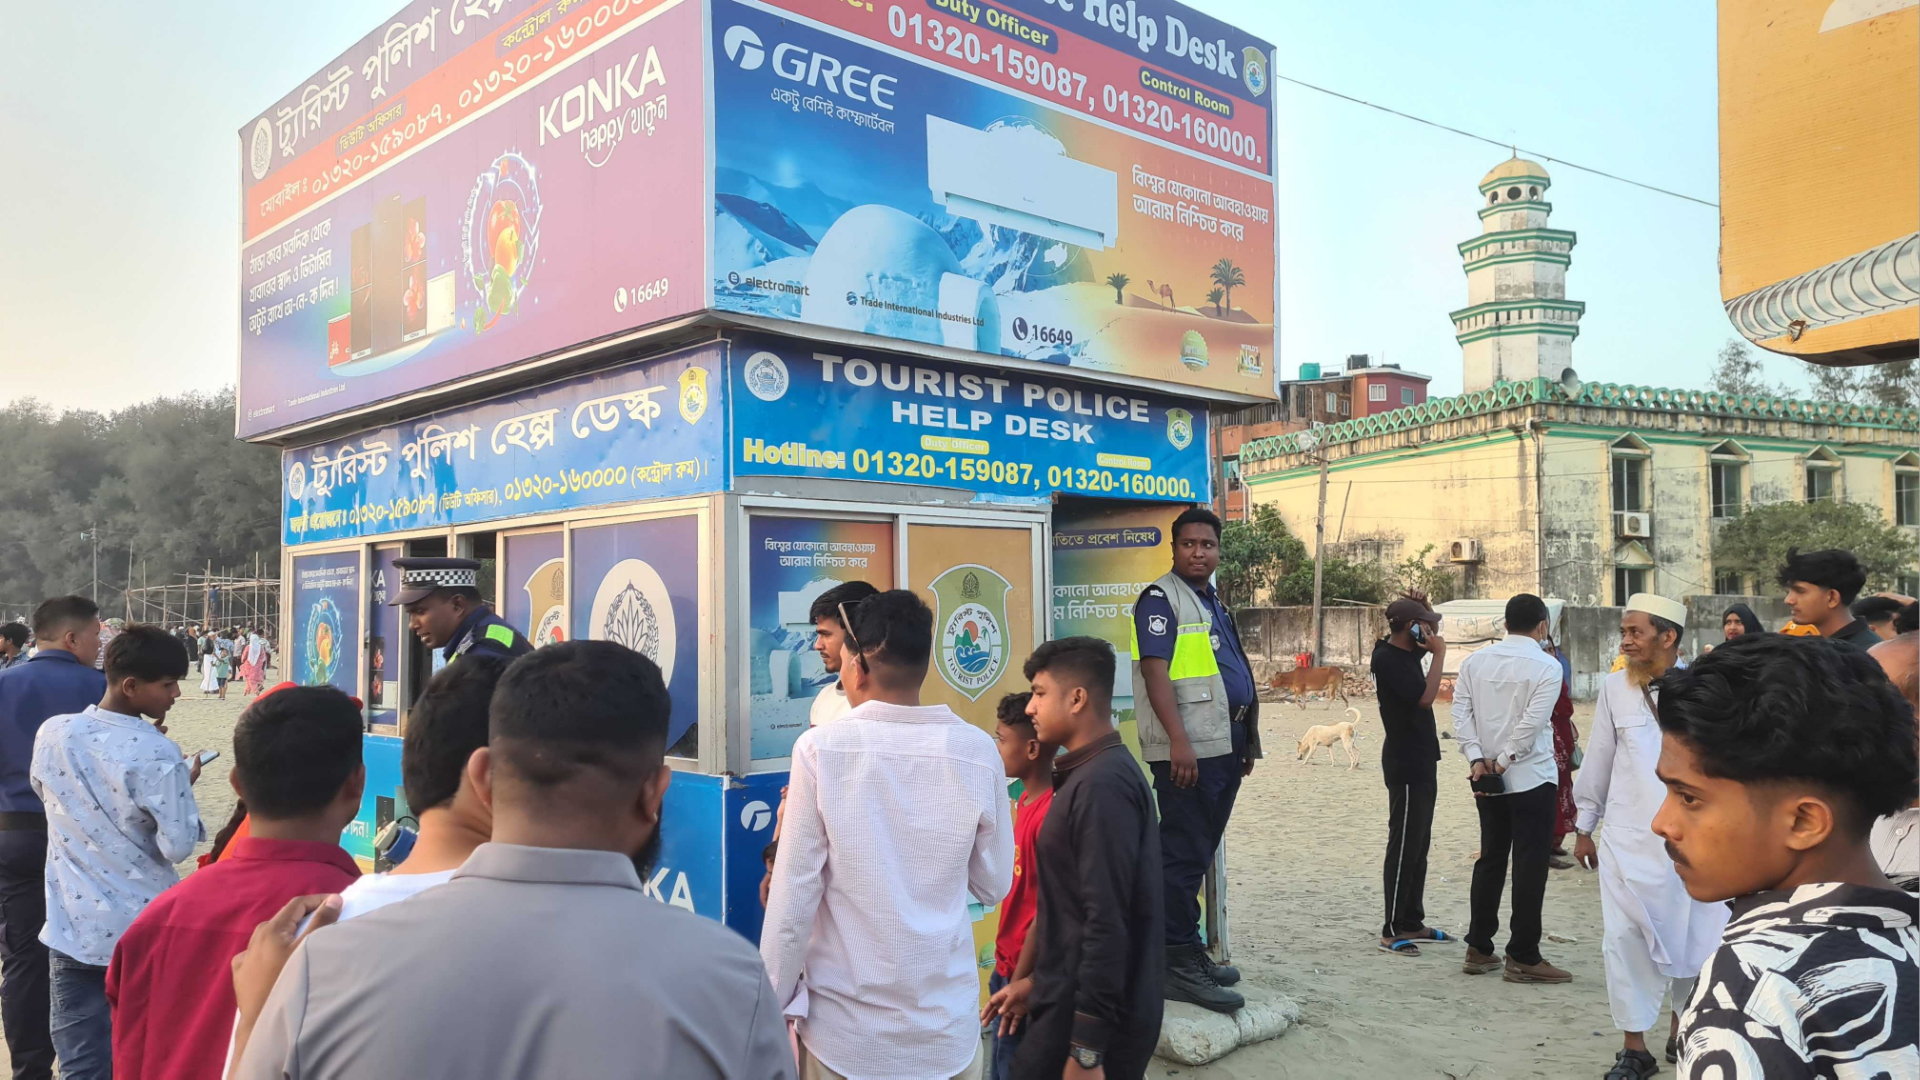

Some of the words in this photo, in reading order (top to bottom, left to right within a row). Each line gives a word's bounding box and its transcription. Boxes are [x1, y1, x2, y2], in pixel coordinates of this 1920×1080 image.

[502, 8, 553, 48] কন্ট্রোল
[986, 8, 1049, 46] Officer
[1083, 0, 1157, 53] Help
[1165, 14, 1237, 79] Desk
[276, 65, 354, 157] ট্যুরিস্ট
[362, 6, 441, 99] পুলিশ
[539, 45, 667, 147] KONKA
[772, 42, 899, 111] GREE
[1140, 70, 1190, 101] Control
[1194, 87, 1230, 116] Room
[630, 93, 668, 137] থাকুন
[771, 87, 801, 113] একটু
[802, 95, 835, 118] বেশিই
[1103, 84, 1263, 163] 01320-160000.
[339, 125, 366, 152] ডিউটি
[366, 103, 404, 133] অফিসার
[580, 106, 631, 153] happy
[1131, 164, 1166, 195] বিশ্বের
[1167, 179, 1211, 207] যেকোনো
[1212, 190, 1269, 225] আবহাওয়ায়
[1132, 194, 1174, 222] আরাম
[1176, 203, 1218, 234] নিশ্চিত
[1219, 220, 1246, 242] করে
[266, 244, 282, 266] করে
[282, 228, 310, 258] সবদিক
[311, 218, 331, 243] থেকে
[249, 276, 277, 303] খাবারের
[293, 266, 299, 283] ও
[300, 247, 332, 280] ভিটামিন
[631, 278, 669, 306] 16649
[745, 276, 810, 296] electromart
[248, 307, 267, 336] অটুট
[267, 301, 284, 326] রাখে
[860, 296, 884, 309] Trade
[884, 299, 934, 318] International
[935, 308, 972, 325] Industries
[972, 316, 985, 327] Ltd
[1032, 324, 1074, 346] 16649
[813, 352, 1010, 403] TOURIST
[1023, 382, 1150, 424] POLICE
[310, 440, 392, 497] ট্যুরিস্ট
[401, 422, 483, 479] পুলিশ
[491, 408, 560, 455] হেল্প
[571, 384, 668, 440] ডেস্ক
[892, 401, 992, 432] HELP
[1005, 413, 1095, 445] DESK
[925, 437, 948, 449] Duty
[743, 438, 846, 471] Hotline:
[852, 448, 1041, 491] 01320-159087,
[1047, 466, 1197, 499] 01320-160000.
[1098, 454, 1126, 466] Control
[1127, 457, 1148, 468] Room
[1087, 533, 1120, 547] প্রবেশ
[1122, 529, 1157, 545] নিষেধ
[371, 569, 386, 588] KA
[779, 555, 811, 568] আরাম
[813, 553, 846, 567] নিশ্চিত
[848, 557, 868, 569] করে
[1053, 584, 1090, 598] কোনো
[1067, 599, 1118, 620] নিশ্চিত
[947, 656, 974, 686] TOURIST
[976, 655, 1000, 685] POLICE
[643, 866, 695, 914] KA
